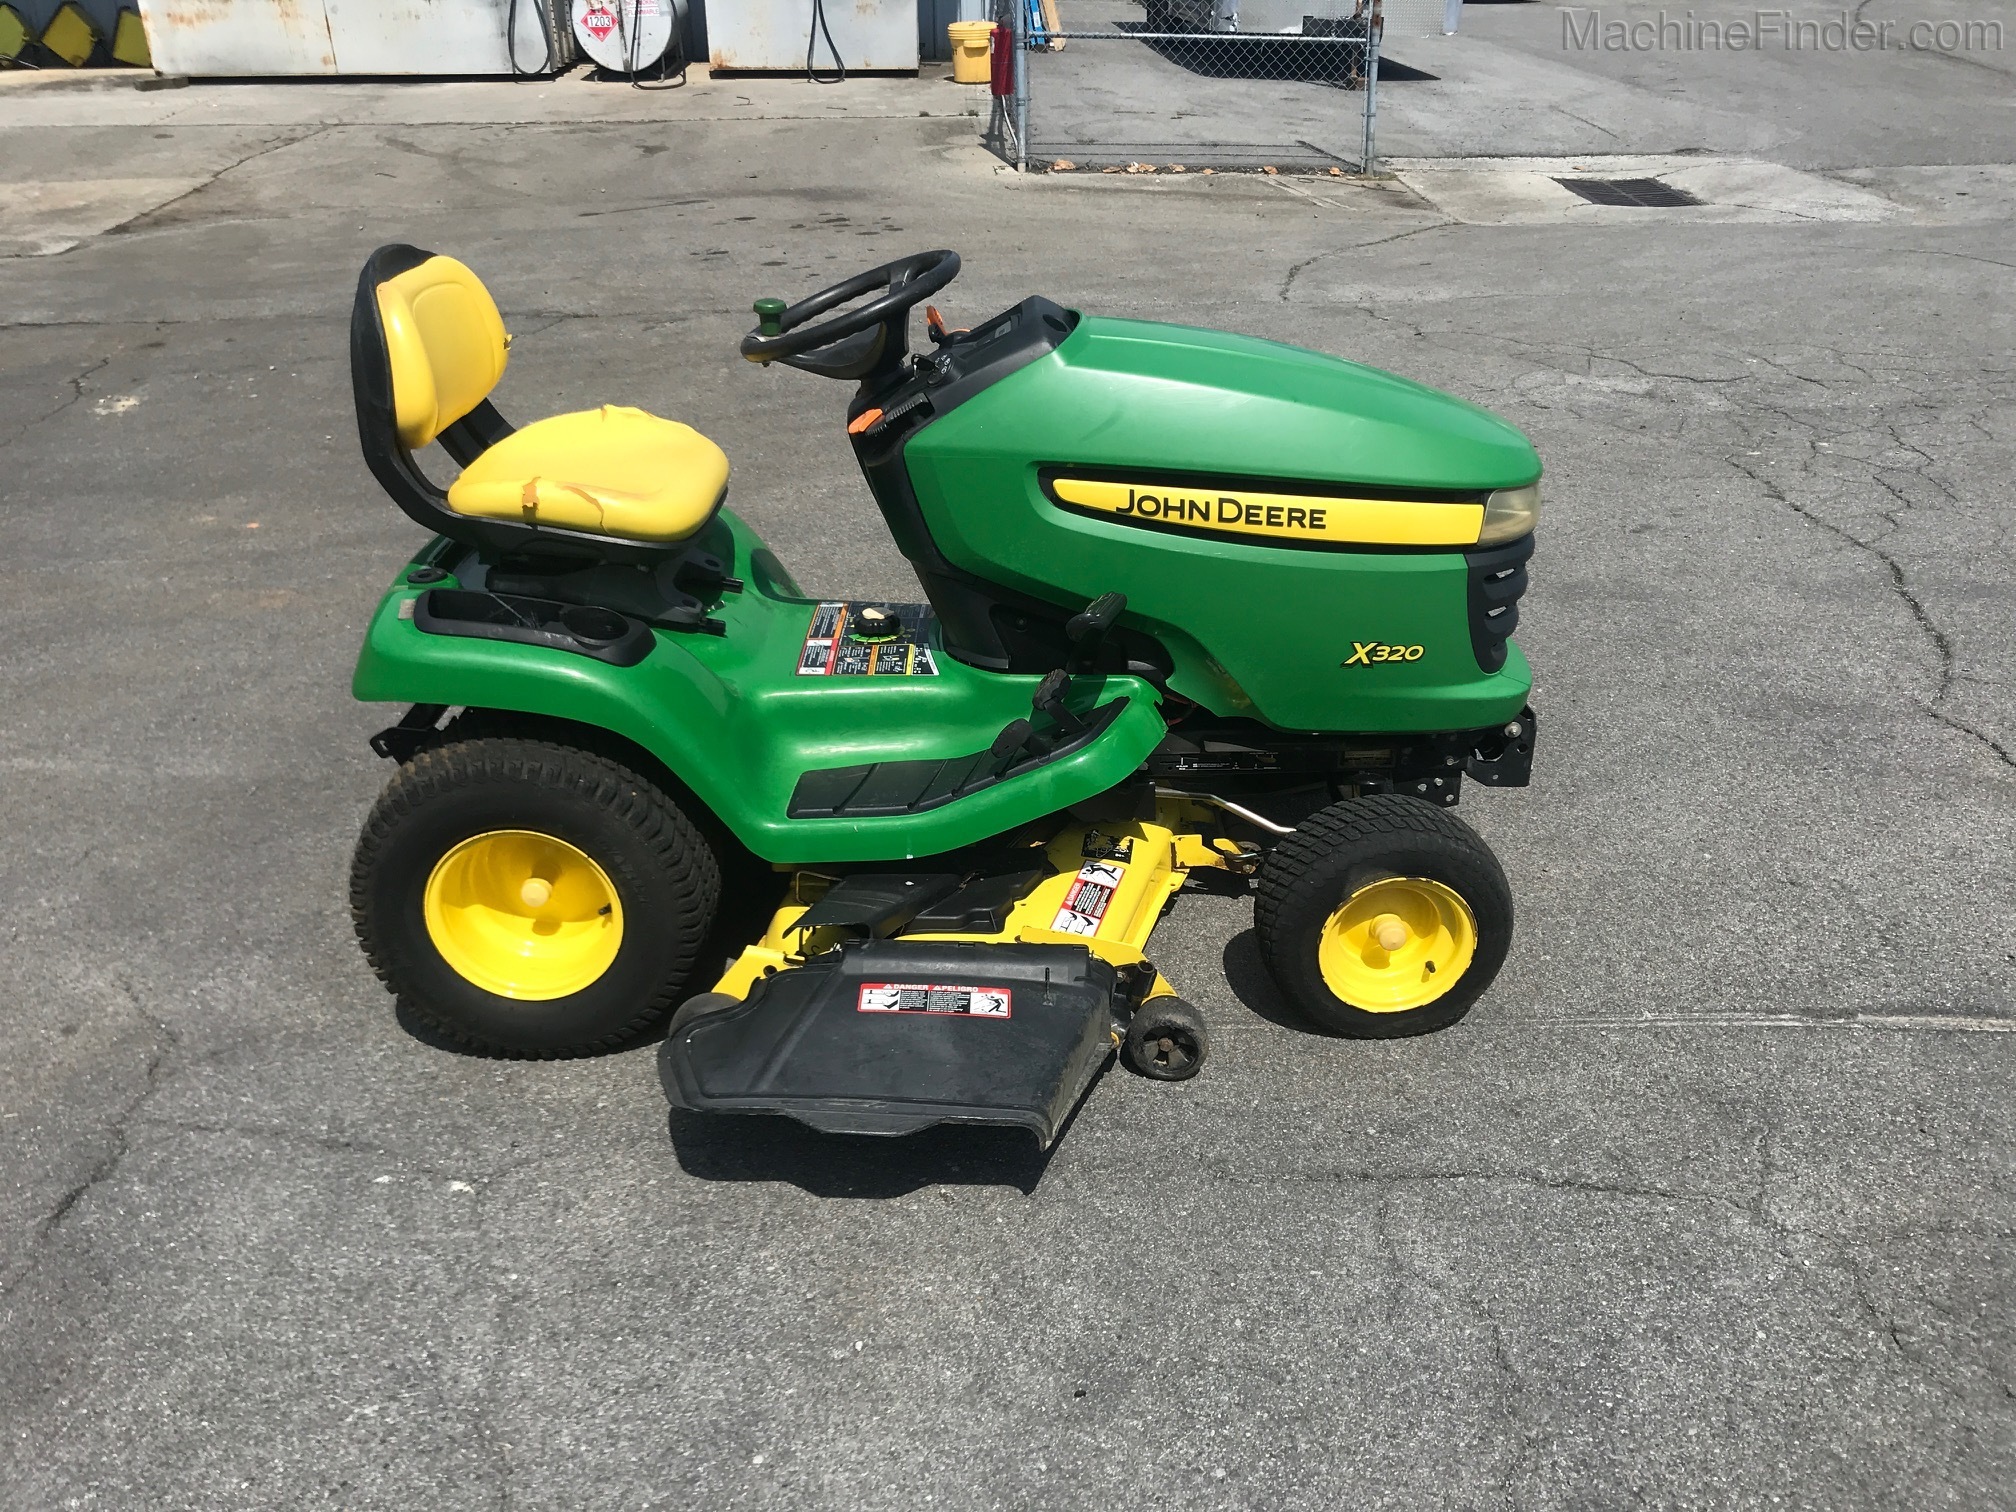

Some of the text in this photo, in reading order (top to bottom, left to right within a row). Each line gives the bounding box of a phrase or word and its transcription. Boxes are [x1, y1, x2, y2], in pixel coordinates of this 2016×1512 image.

[589, 16, 611, 27] 1203
[1116, 489, 1326, 530] JOHN DEERE
[1341, 641, 1425, 667] X320
[1066, 882, 1081, 901] DANGER
[941, 985, 979, 993] PELIGRO
